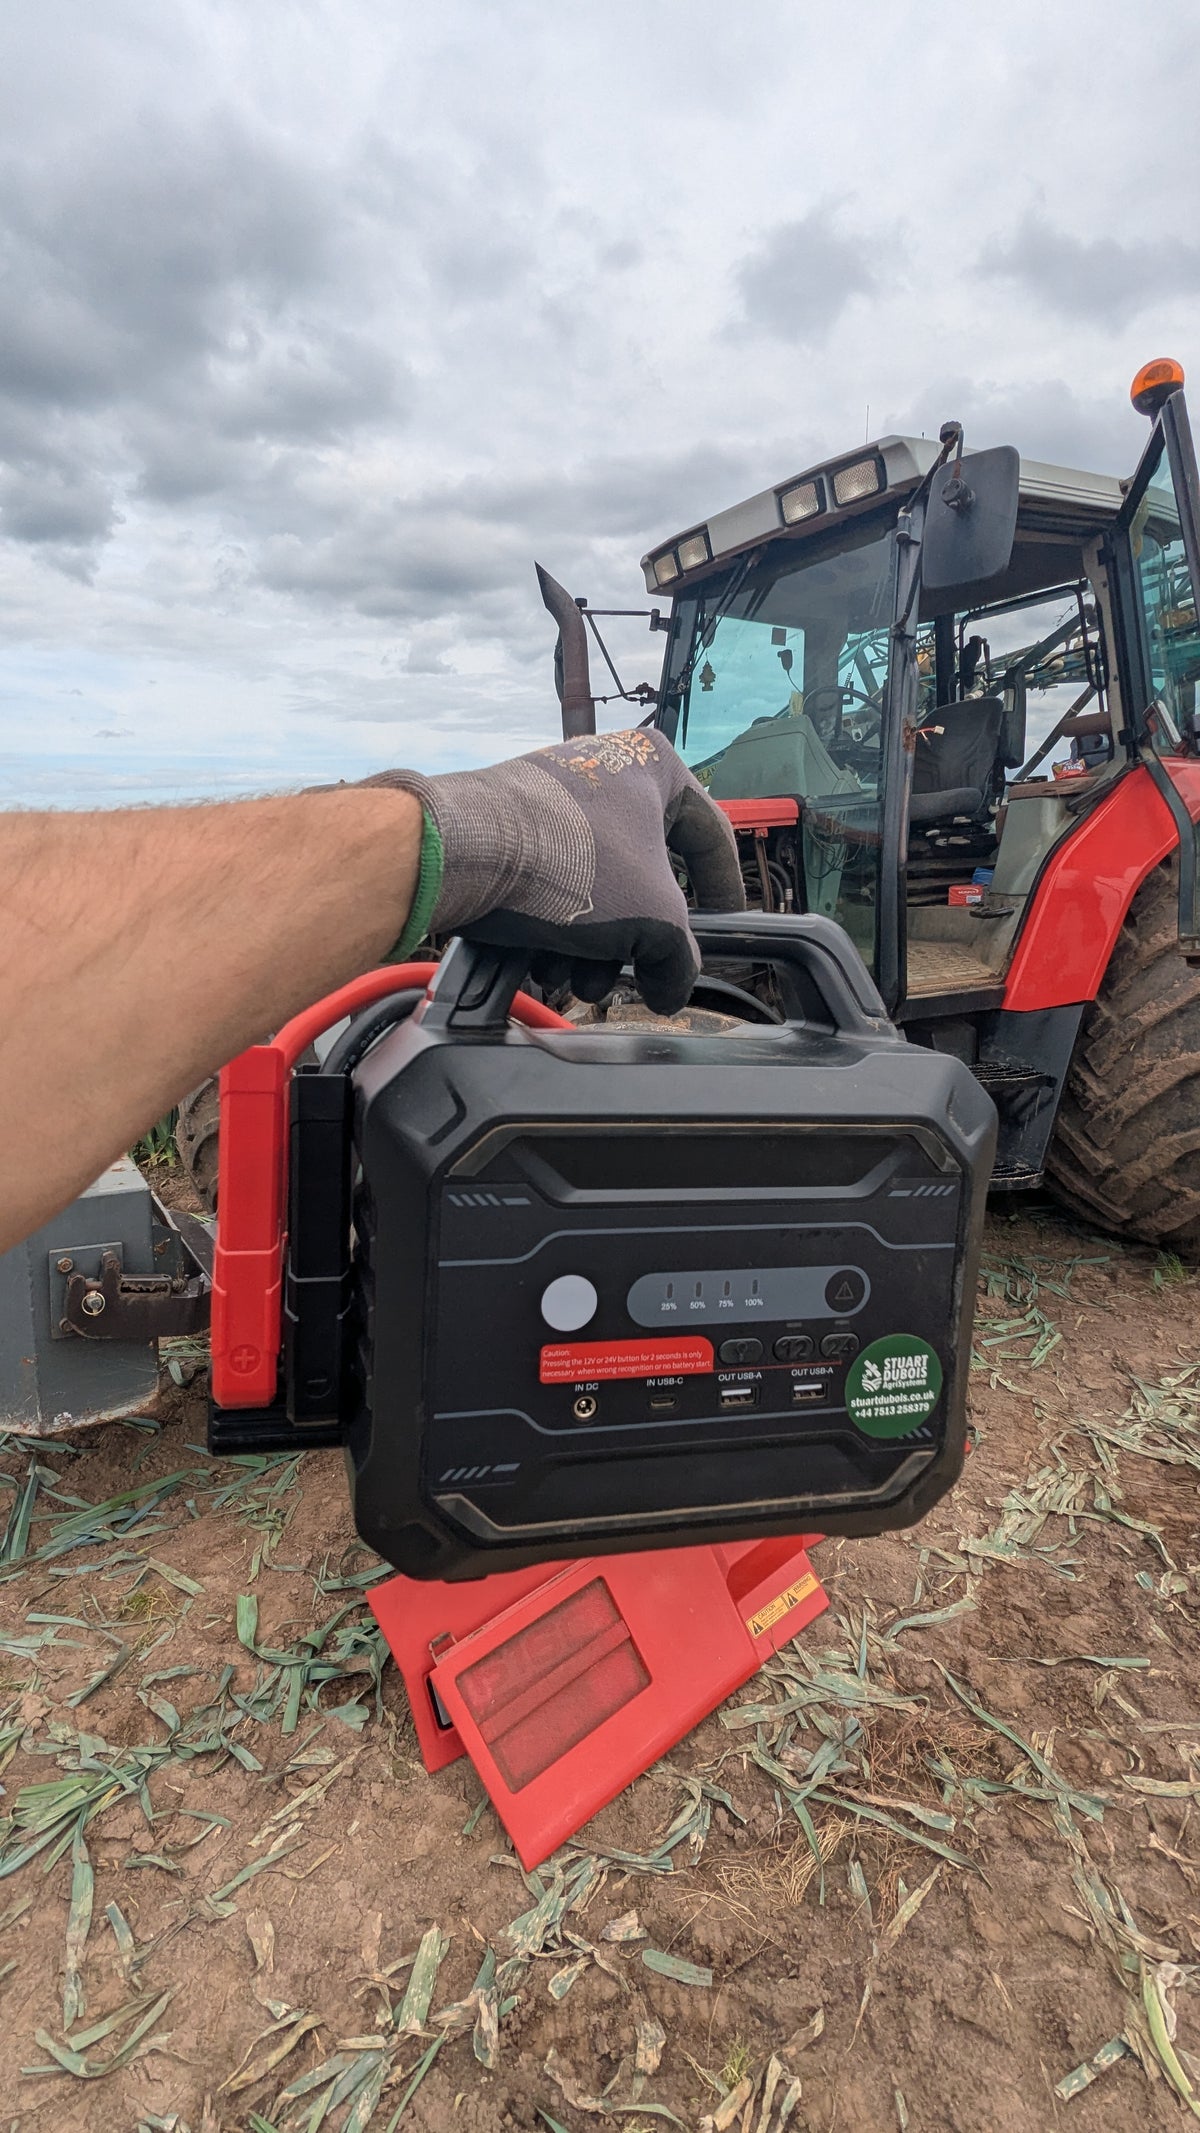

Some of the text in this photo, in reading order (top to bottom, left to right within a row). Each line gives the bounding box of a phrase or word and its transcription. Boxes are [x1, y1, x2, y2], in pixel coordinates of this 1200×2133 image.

[661, 1302, 677, 1311] 25%
[690, 1301, 706, 1310] 50%
[718, 1299, 734, 1308] 75%
[745, 1298, 763, 1307] 100%
[543, 1360, 571, 1368] Pressing
[571, 1358, 582, 1366] the
[584, 1357, 595, 1365] 12V
[604, 1356, 617, 1364] 24V
[641, 1353, 650, 1361] for
[656, 1352, 681, 1360] seconds
[689, 1351, 702, 1359] only
[884, 1354, 929, 1370] STUART
[543, 1369, 575, 1377] necessary
[577, 1367, 595, 1375] when
[597, 1366, 617, 1374] wrong
[618, 1363, 653, 1374] recognition
[672, 1361, 695, 1370] battery
[791, 1366, 834, 1377] OUT USB-A
[883, 1366, 928, 1381] DUBOIS
[647, 1377, 683, 1387] IN USB-C
[718, 1371, 762, 1382] OUT USB-A
[575, 1383, 599, 1392] IN DC
[882, 1379, 927, 1390] AgriSystems
[850, 1390, 935, 1408] stuartdubois.co.uk
[855, 1408, 872, 1418] +44
[874, 1406, 896, 1417] 7513
